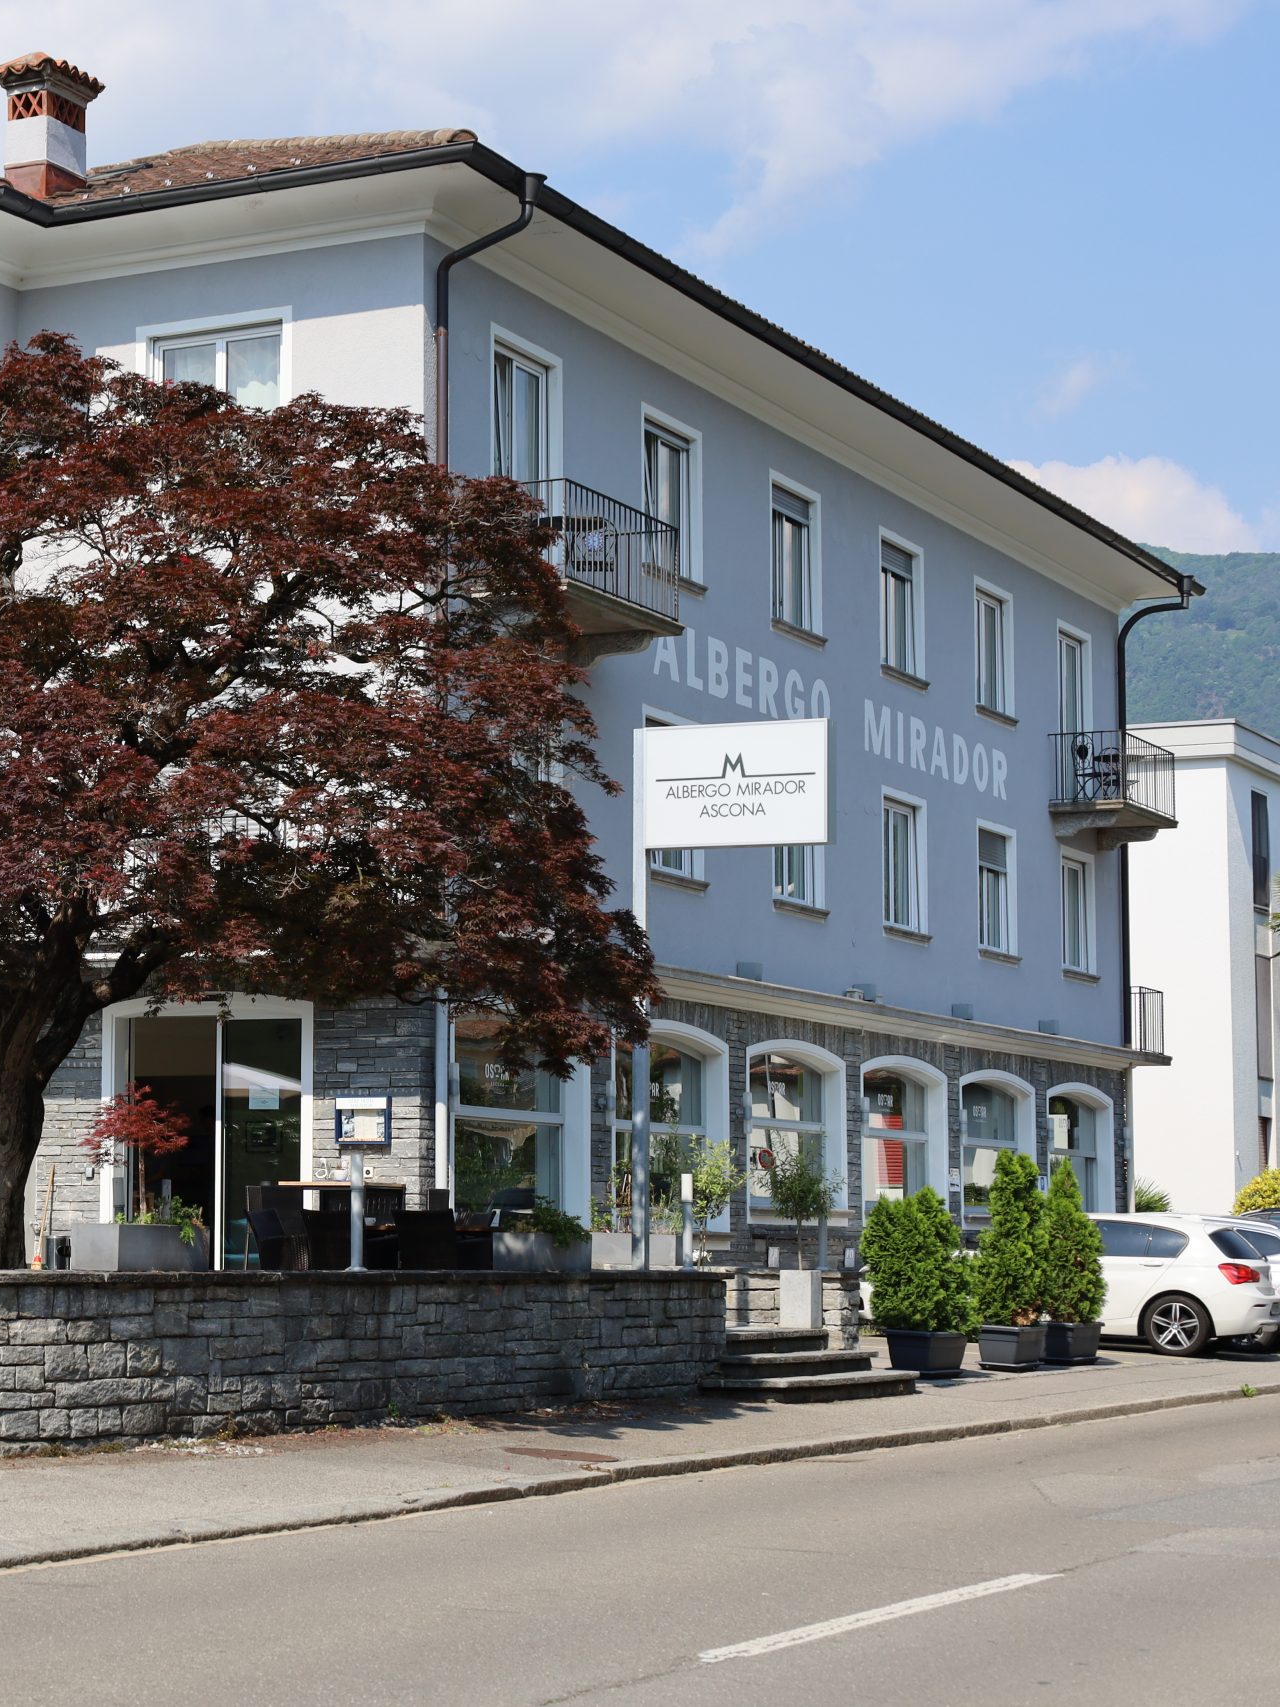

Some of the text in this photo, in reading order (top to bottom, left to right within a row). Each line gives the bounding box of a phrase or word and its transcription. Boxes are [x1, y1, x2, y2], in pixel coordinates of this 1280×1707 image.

[653, 627, 1008, 801] ALBERGO MIRADOR
[721, 752, 746, 778] M
[665, 779, 806, 800] ALBERGO MIRADOR
[699, 802, 766, 819] ASCONA
